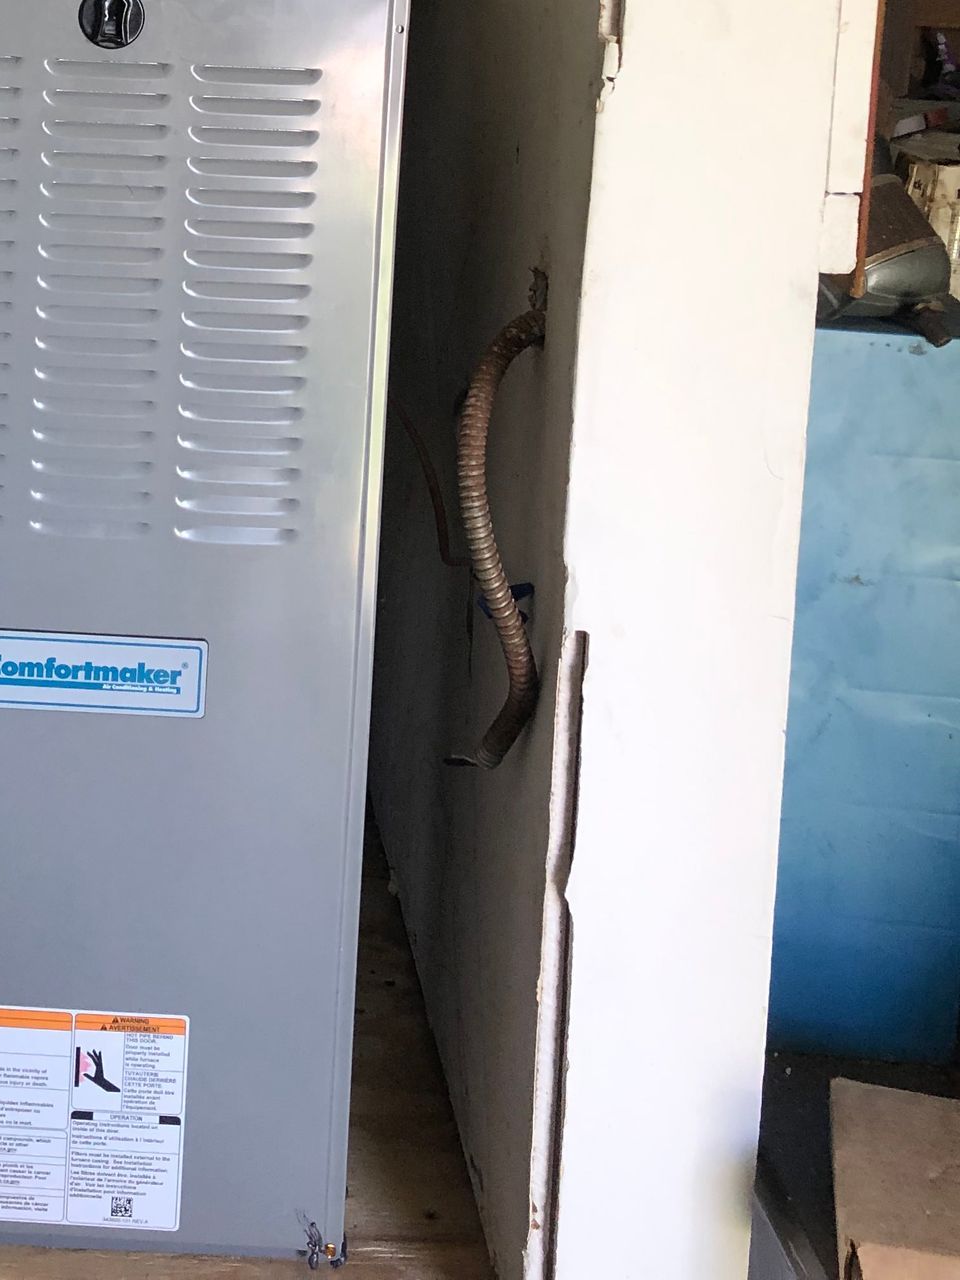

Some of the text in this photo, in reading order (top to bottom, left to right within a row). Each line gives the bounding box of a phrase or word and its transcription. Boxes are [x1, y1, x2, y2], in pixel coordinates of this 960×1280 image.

[112, 684, 148, 694] Conditioning
[154, 687, 178, 695] Heating
[109, 1024, 159, 1033] AVERTISSEMENT
